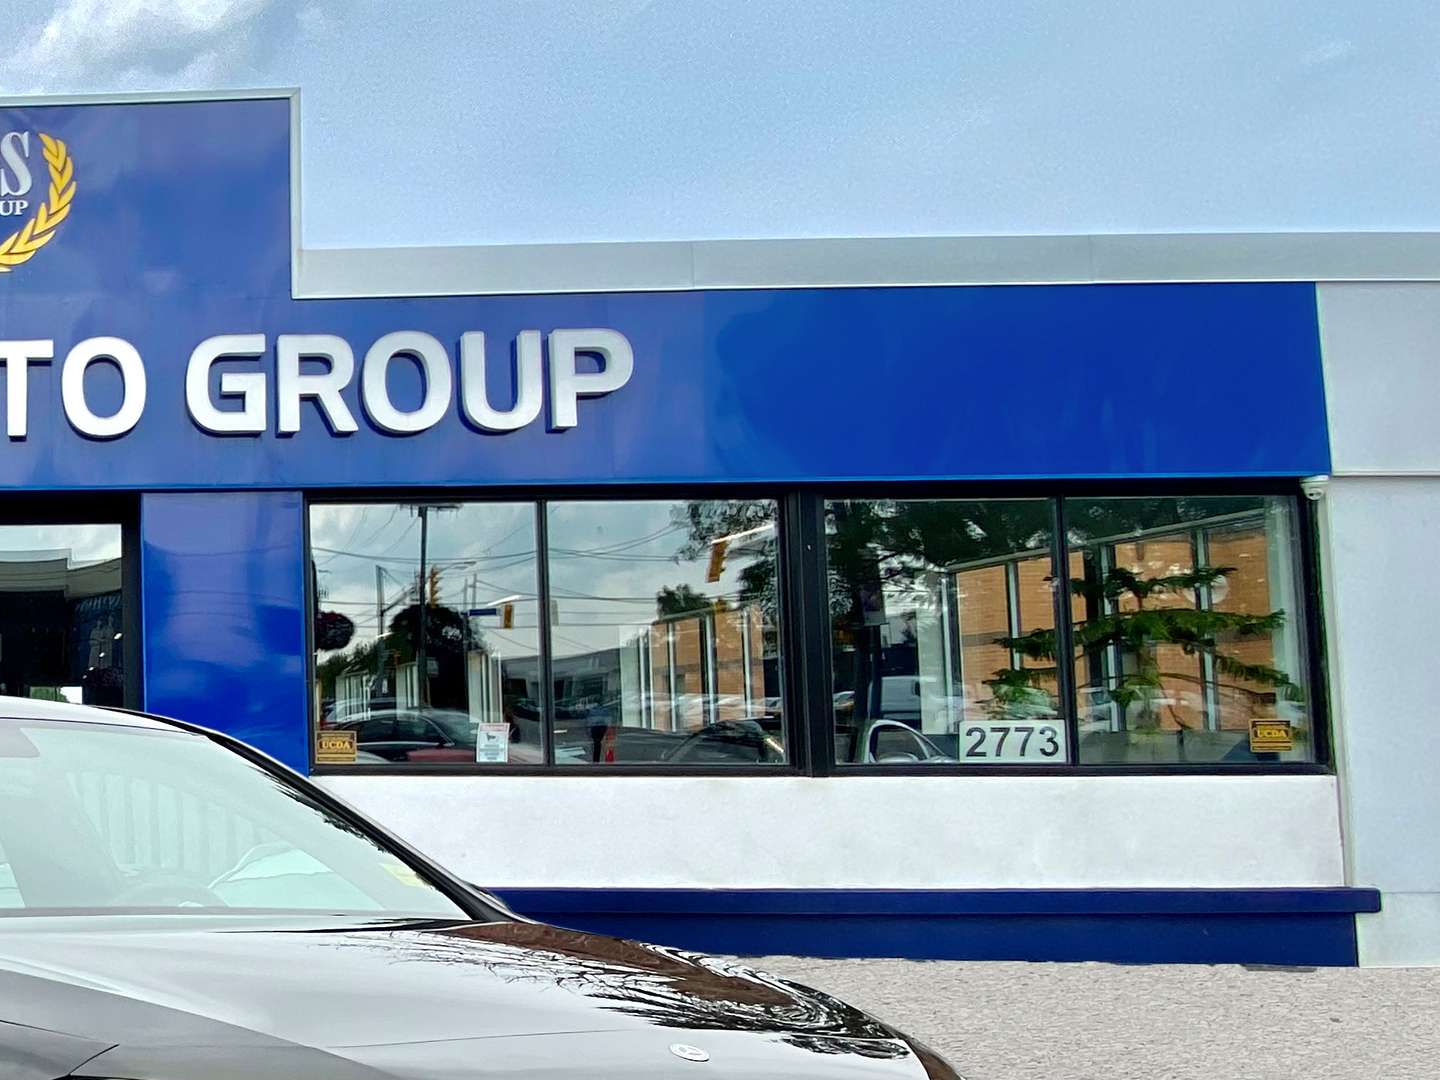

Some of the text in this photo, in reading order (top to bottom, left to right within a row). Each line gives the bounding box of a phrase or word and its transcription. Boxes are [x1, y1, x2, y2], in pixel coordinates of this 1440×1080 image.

[185, 328, 634, 436] GROUP
[966, 727, 1059, 757] 2773
[1257, 729, 1288, 738] UCDA
[321, 740, 351, 749] UCDA
